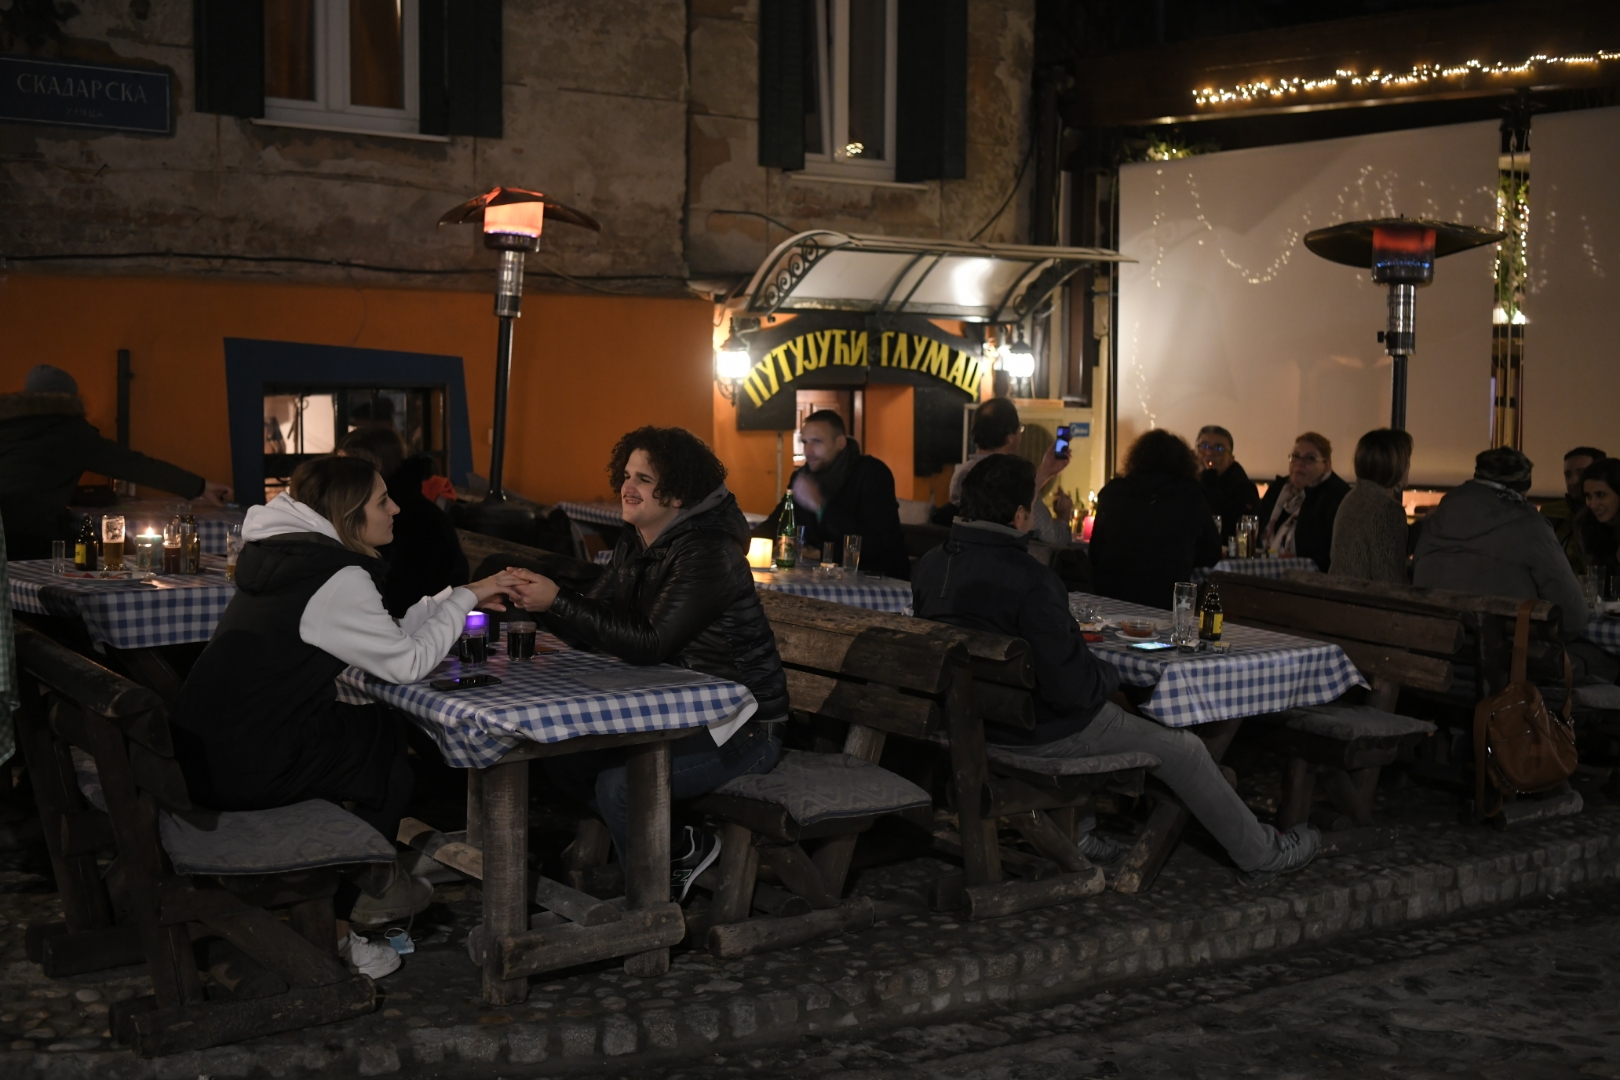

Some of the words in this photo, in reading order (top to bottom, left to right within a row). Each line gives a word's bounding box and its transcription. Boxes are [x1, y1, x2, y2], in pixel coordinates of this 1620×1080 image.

[17, 73, 148, 104] СКАДАРСКА
[743, 328, 869, 409] ПУТУЈУЋИ
[880, 330, 985, 402] ГЛУМАЦ
